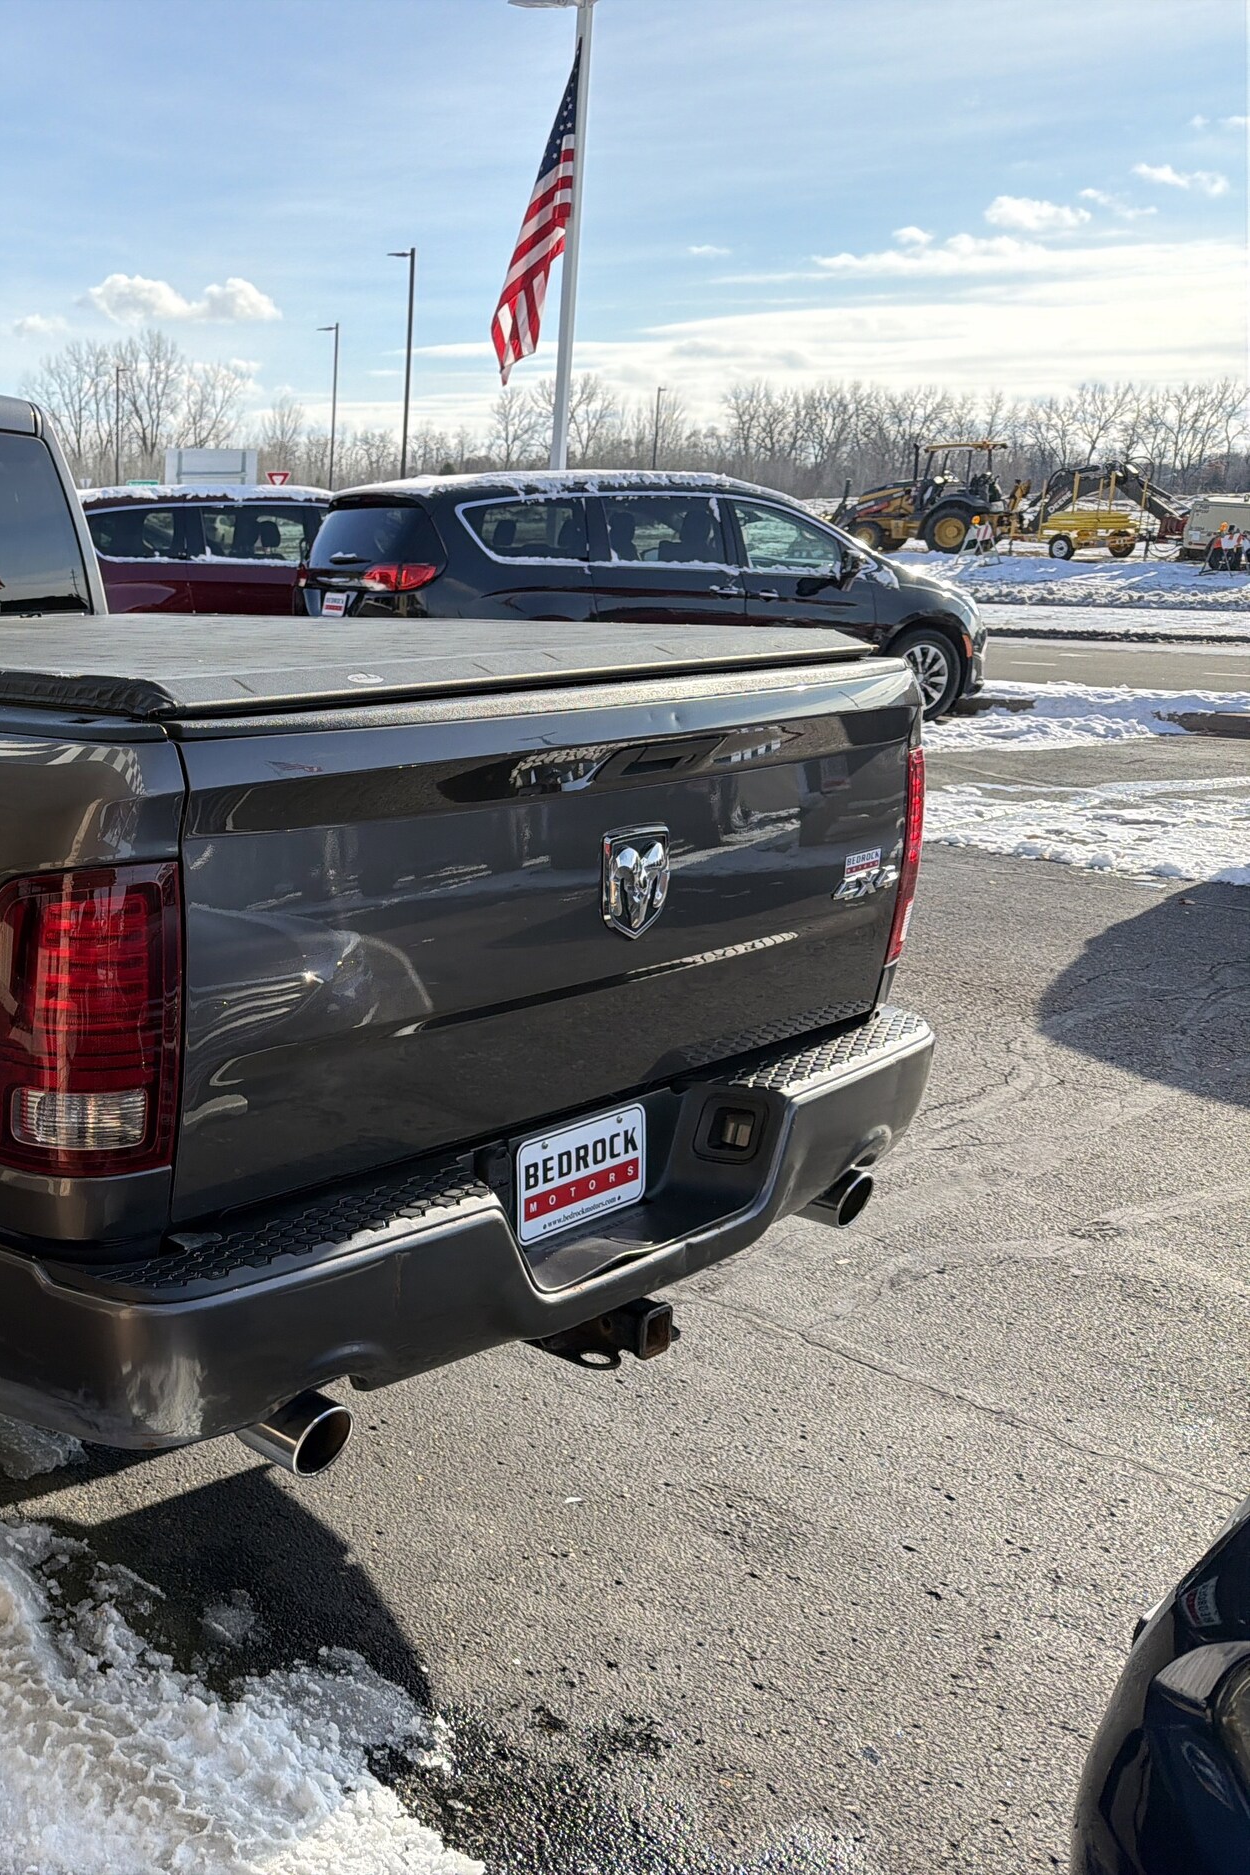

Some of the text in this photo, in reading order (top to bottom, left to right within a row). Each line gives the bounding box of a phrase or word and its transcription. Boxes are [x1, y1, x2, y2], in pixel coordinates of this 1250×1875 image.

[846, 850, 880, 866] BEDROCK
[524, 1127, 638, 1191] BEDROCK
[529, 1165, 634, 1213] MOTORS
[547, 1197, 617, 1227] www.bedrockmotors.com
